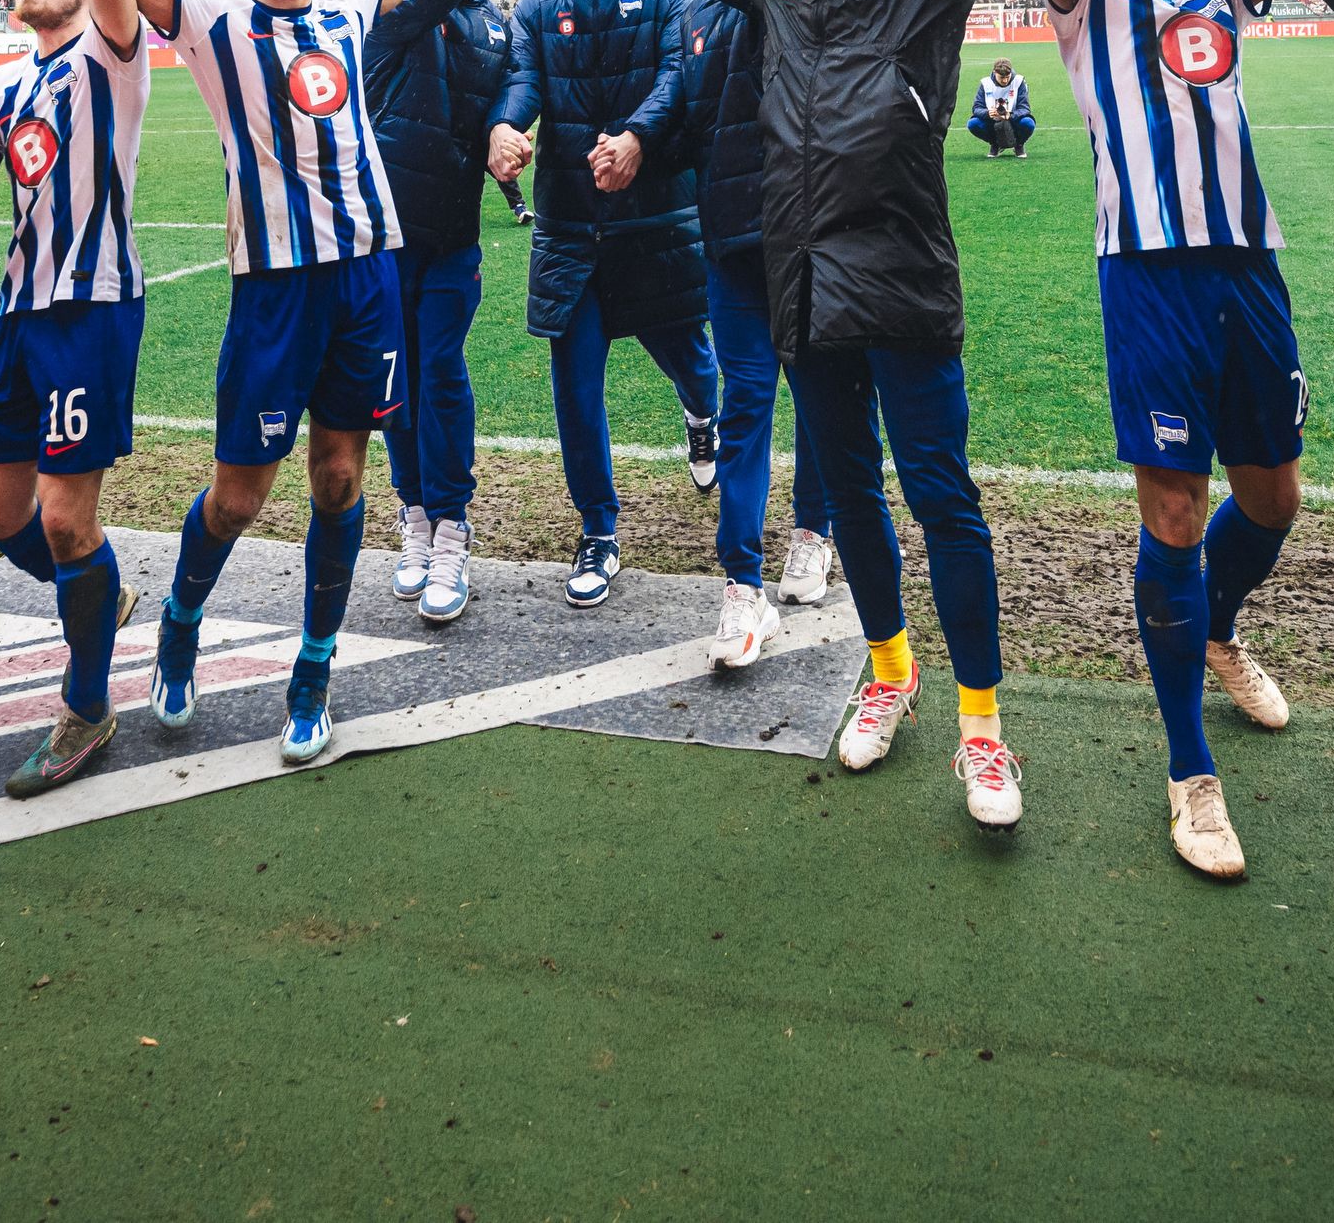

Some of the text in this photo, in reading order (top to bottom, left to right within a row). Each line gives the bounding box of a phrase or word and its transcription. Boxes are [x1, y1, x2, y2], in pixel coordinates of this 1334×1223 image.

[562, 22, 572, 33] B
[1243, 23, 1318, 38] DICH JETZT!
[1270, 7, 1304, 15] Muskeln
[1177, 27, 1218, 72] B
[300, 65, 337, 107] B
[14, 133, 47, 178] B
[382, 350, 397, 401] 7
[45, 387, 89, 443] 16
